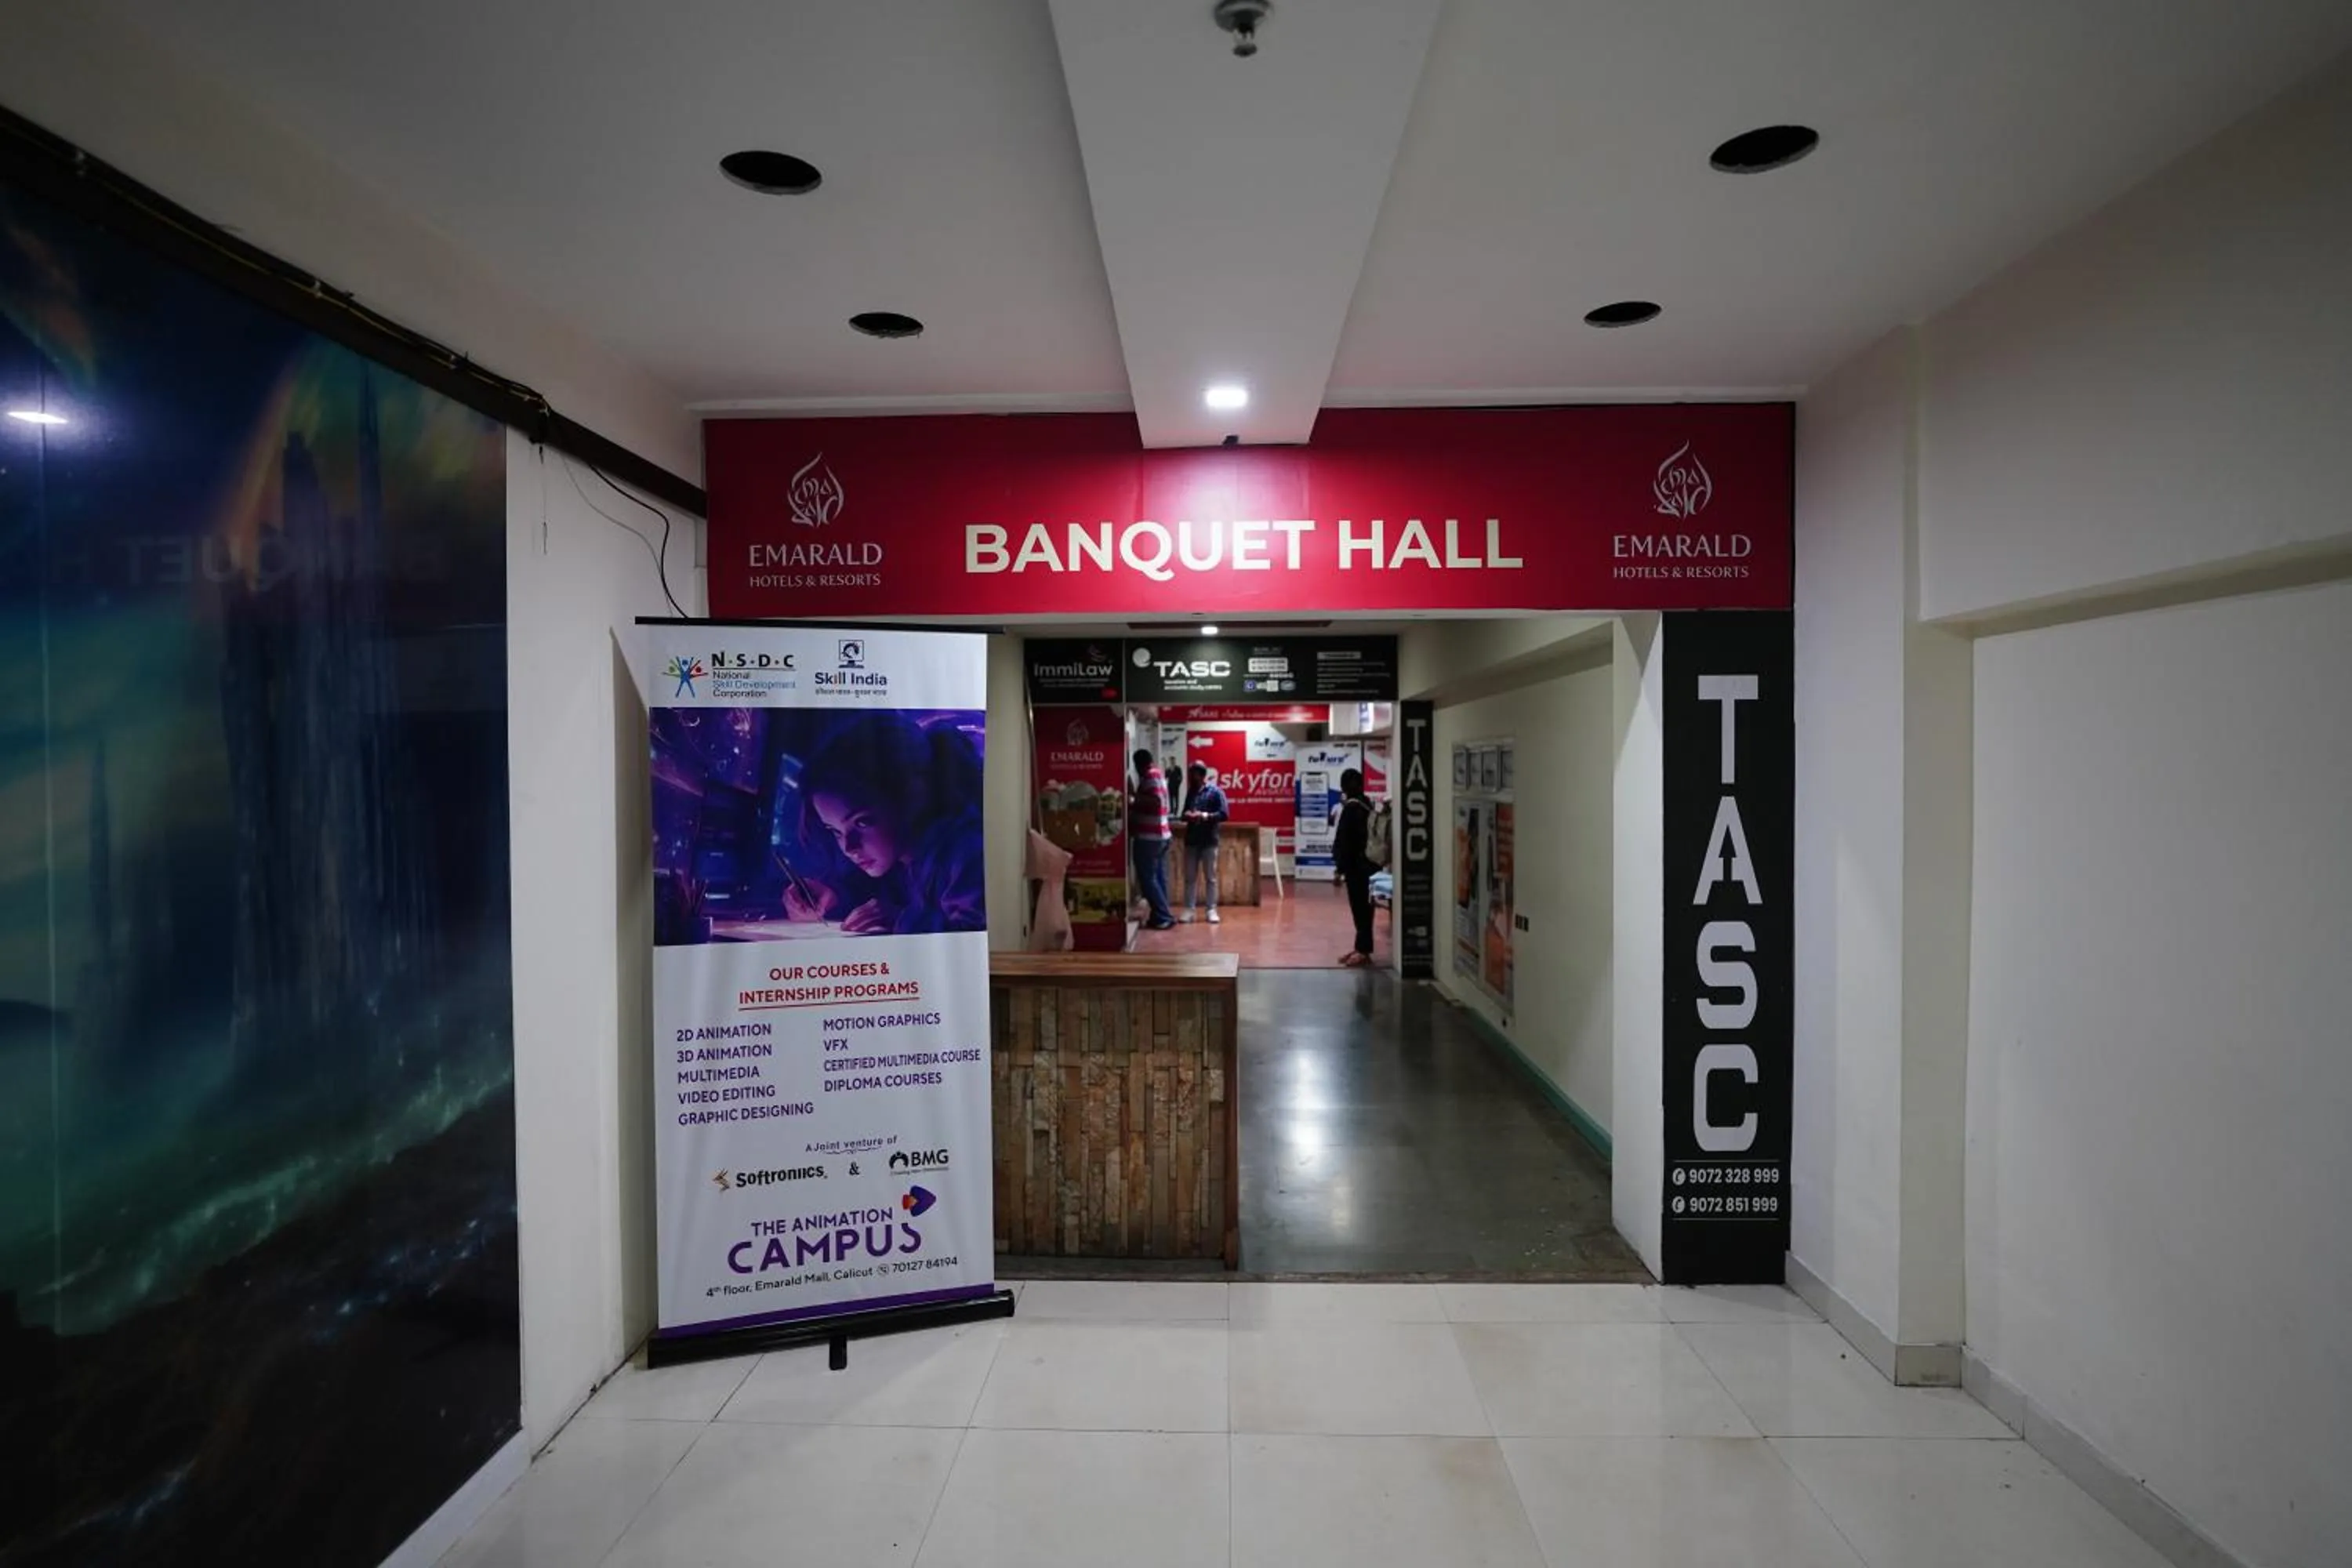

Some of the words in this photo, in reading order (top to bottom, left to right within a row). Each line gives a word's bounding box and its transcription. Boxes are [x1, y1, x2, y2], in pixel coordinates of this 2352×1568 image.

[748, 542, 883, 567] EMARALD
[964, 519, 1316, 582] BANQUET
[1339, 519, 1523, 570] HALL
[1613, 534, 1752, 558] EMARALD
[749, 575, 803, 589] HOTELS
[804, 574, 818, 588] &
[819, 572, 881, 587] RESORTS
[1613, 566, 1669, 579] HOTELS
[1671, 566, 1682, 579] &
[1686, 565, 1750, 579] RESORTS
[713, 670, 750, 680] National
[814, 671, 847, 686] Skill
[850, 672, 888, 687] India
[1152, 660, 1231, 678] TASC
[712, 689, 768, 699] Corporation
[713, 680, 733, 688] Skill
[735, 680, 797, 690] Development
[1406, 719, 1428, 860] TASC
[1692, 674, 1763, 1152] TASC
[769, 967, 804, 982] OUR
[806, 964, 878, 979] COURSES
[880, 963, 891, 976] &
[739, 985, 831, 1005] INTERNSHIP
[833, 981, 920, 1000] PROGRAMS
[676, 1029, 694, 1043] 2D
[695, 1022, 772, 1041] ANIMATION
[823, 1016, 876, 1033] MOTION
[877, 1012, 942, 1029] GRAPHICS
[676, 1049, 695, 1064] 3D
[695, 1043, 772, 1062] ANIMATION
[823, 1038, 849, 1053] VFX
[823, 1057, 877, 1073] CERTIFIED
[877, 1051, 941, 1069] MULTIMEDIA
[940, 1048, 982, 1065] COURSE
[677, 1065, 760, 1085] MULTIMEDIA
[823, 1076, 882, 1093] DIPLOMA
[884, 1072, 942, 1088] COURSES
[678, 1089, 720, 1105] VIDEO
[722, 1084, 776, 1102] EDITING
[677, 1107, 739, 1126] GRAPHIC
[741, 1101, 815, 1121] DESIGNING
[804, 1143, 812, 1152] A
[814, 1141, 840, 1152] Joint
[843, 1138, 884, 1149] venture
[887, 1134, 898, 1145] of
[849, 1161, 861, 1177] &
[910, 1149, 949, 1167] BMG
[1689, 1167, 1722, 1185] 9072
[1725, 1167, 1751, 1185] 328
[1753, 1167, 1780, 1185] 999
[1689, 1196, 1723, 1213] 9072
[1725, 1196, 1749, 1213] 851
[1751, 1196, 1778, 1213] 999
[750, 1218, 787, 1238] THE
[791, 1206, 895, 1232] ANIMATION
[726, 1221, 923, 1275] CAMPUS
[723, 1283, 753, 1297] floor,
[754, 1274, 803, 1292] Emarald
[833, 1266, 874, 1282] Calicut
[891, 1260, 924, 1275] 70127
[925, 1255, 959, 1270] 84194
